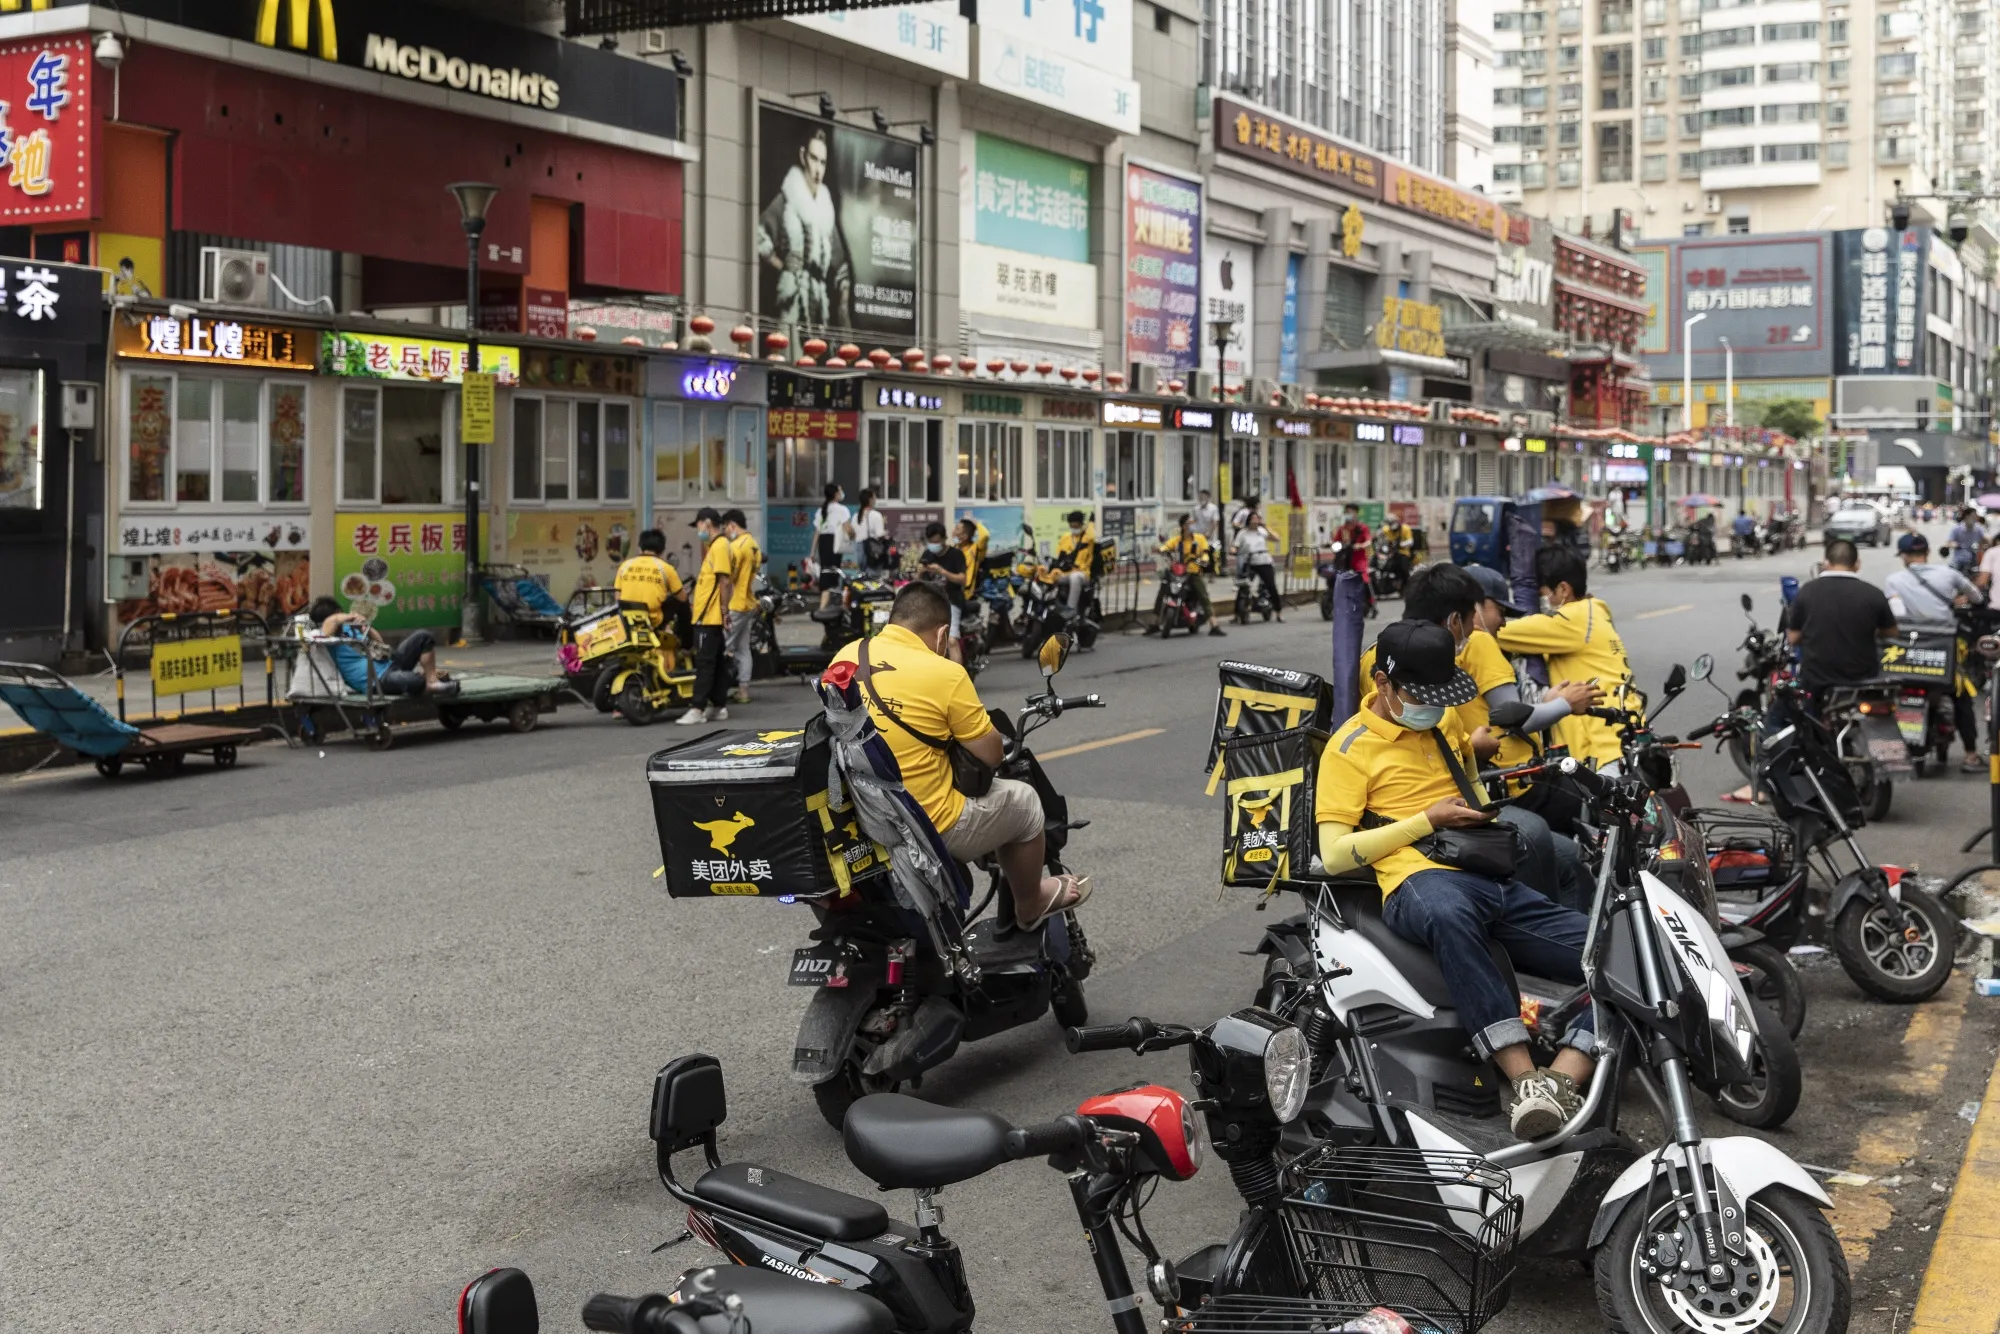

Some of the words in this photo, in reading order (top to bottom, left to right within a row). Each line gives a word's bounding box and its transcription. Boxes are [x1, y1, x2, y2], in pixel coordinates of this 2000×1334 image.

[364, 32, 561, 110] McDonald's
[977, 170, 1089, 232] 黄河生活超市
[1686, 285, 1814, 312] 南方国际影城
[149, 315, 244, 360] 煌上煌
[768, 410, 853, 439] 饮品买一送一
[122, 526, 172, 547] 煌上煌
[1242, 830, 1279, 849] 美团外卖
[691, 858, 774, 882] 美团外卖
[715, 884, 754, 895] 美团专送
[1704, 1226, 1717, 1256] YADEA
[760, 1254, 817, 1283] FASHION
